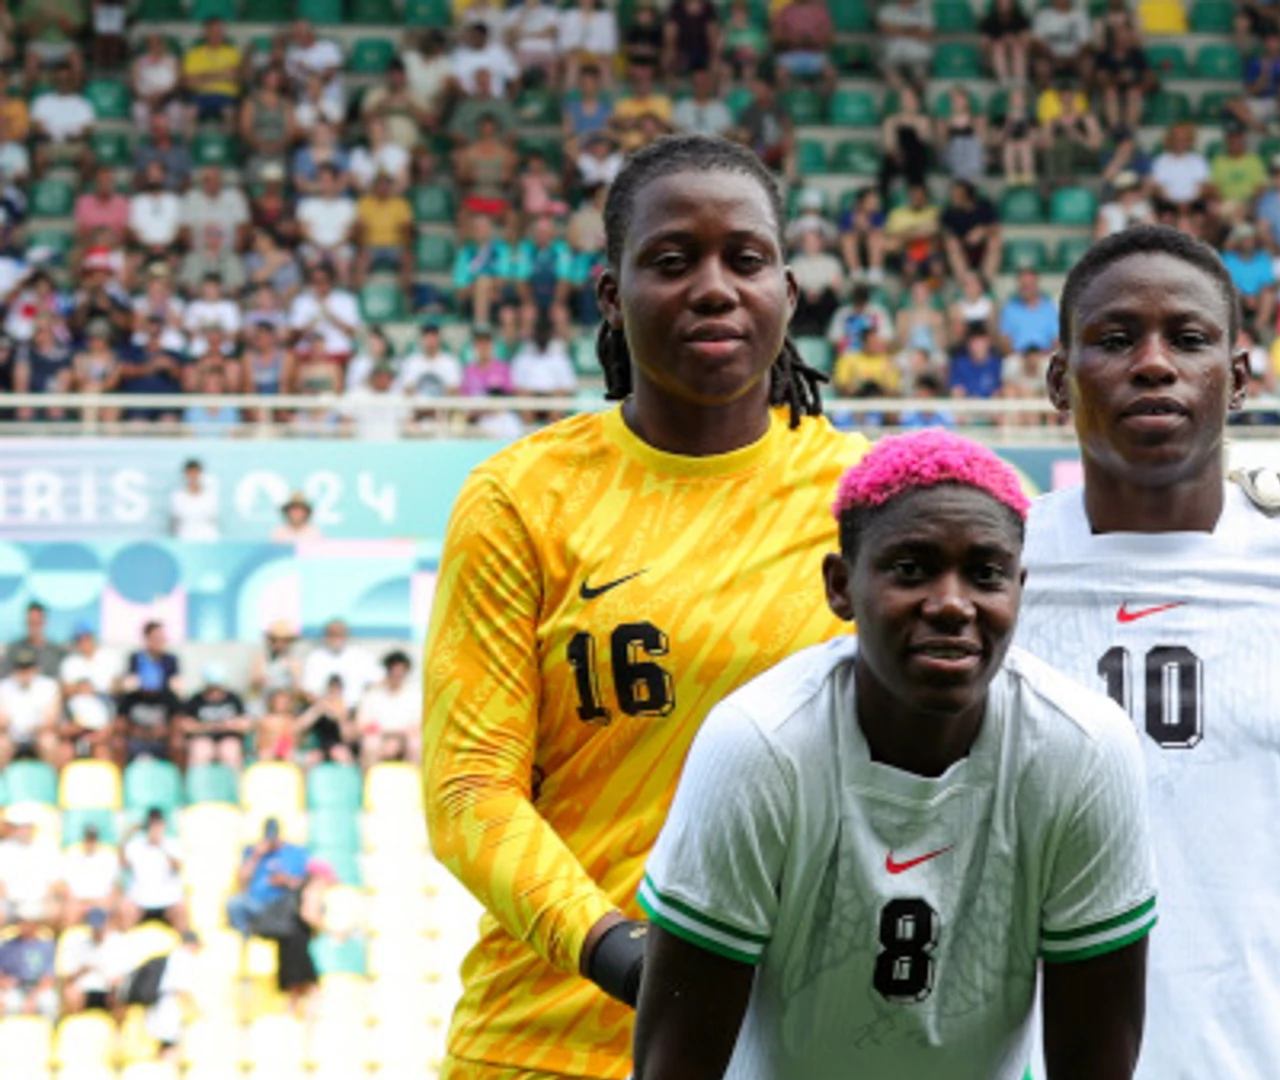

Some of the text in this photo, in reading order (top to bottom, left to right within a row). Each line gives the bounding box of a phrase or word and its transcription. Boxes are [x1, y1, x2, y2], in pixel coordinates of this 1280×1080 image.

[0, 468, 150, 523] RIS
[567, 621, 675, 726] 16
[1098, 645, 1203, 749] 10
[872, 897, 941, 1004] 8
